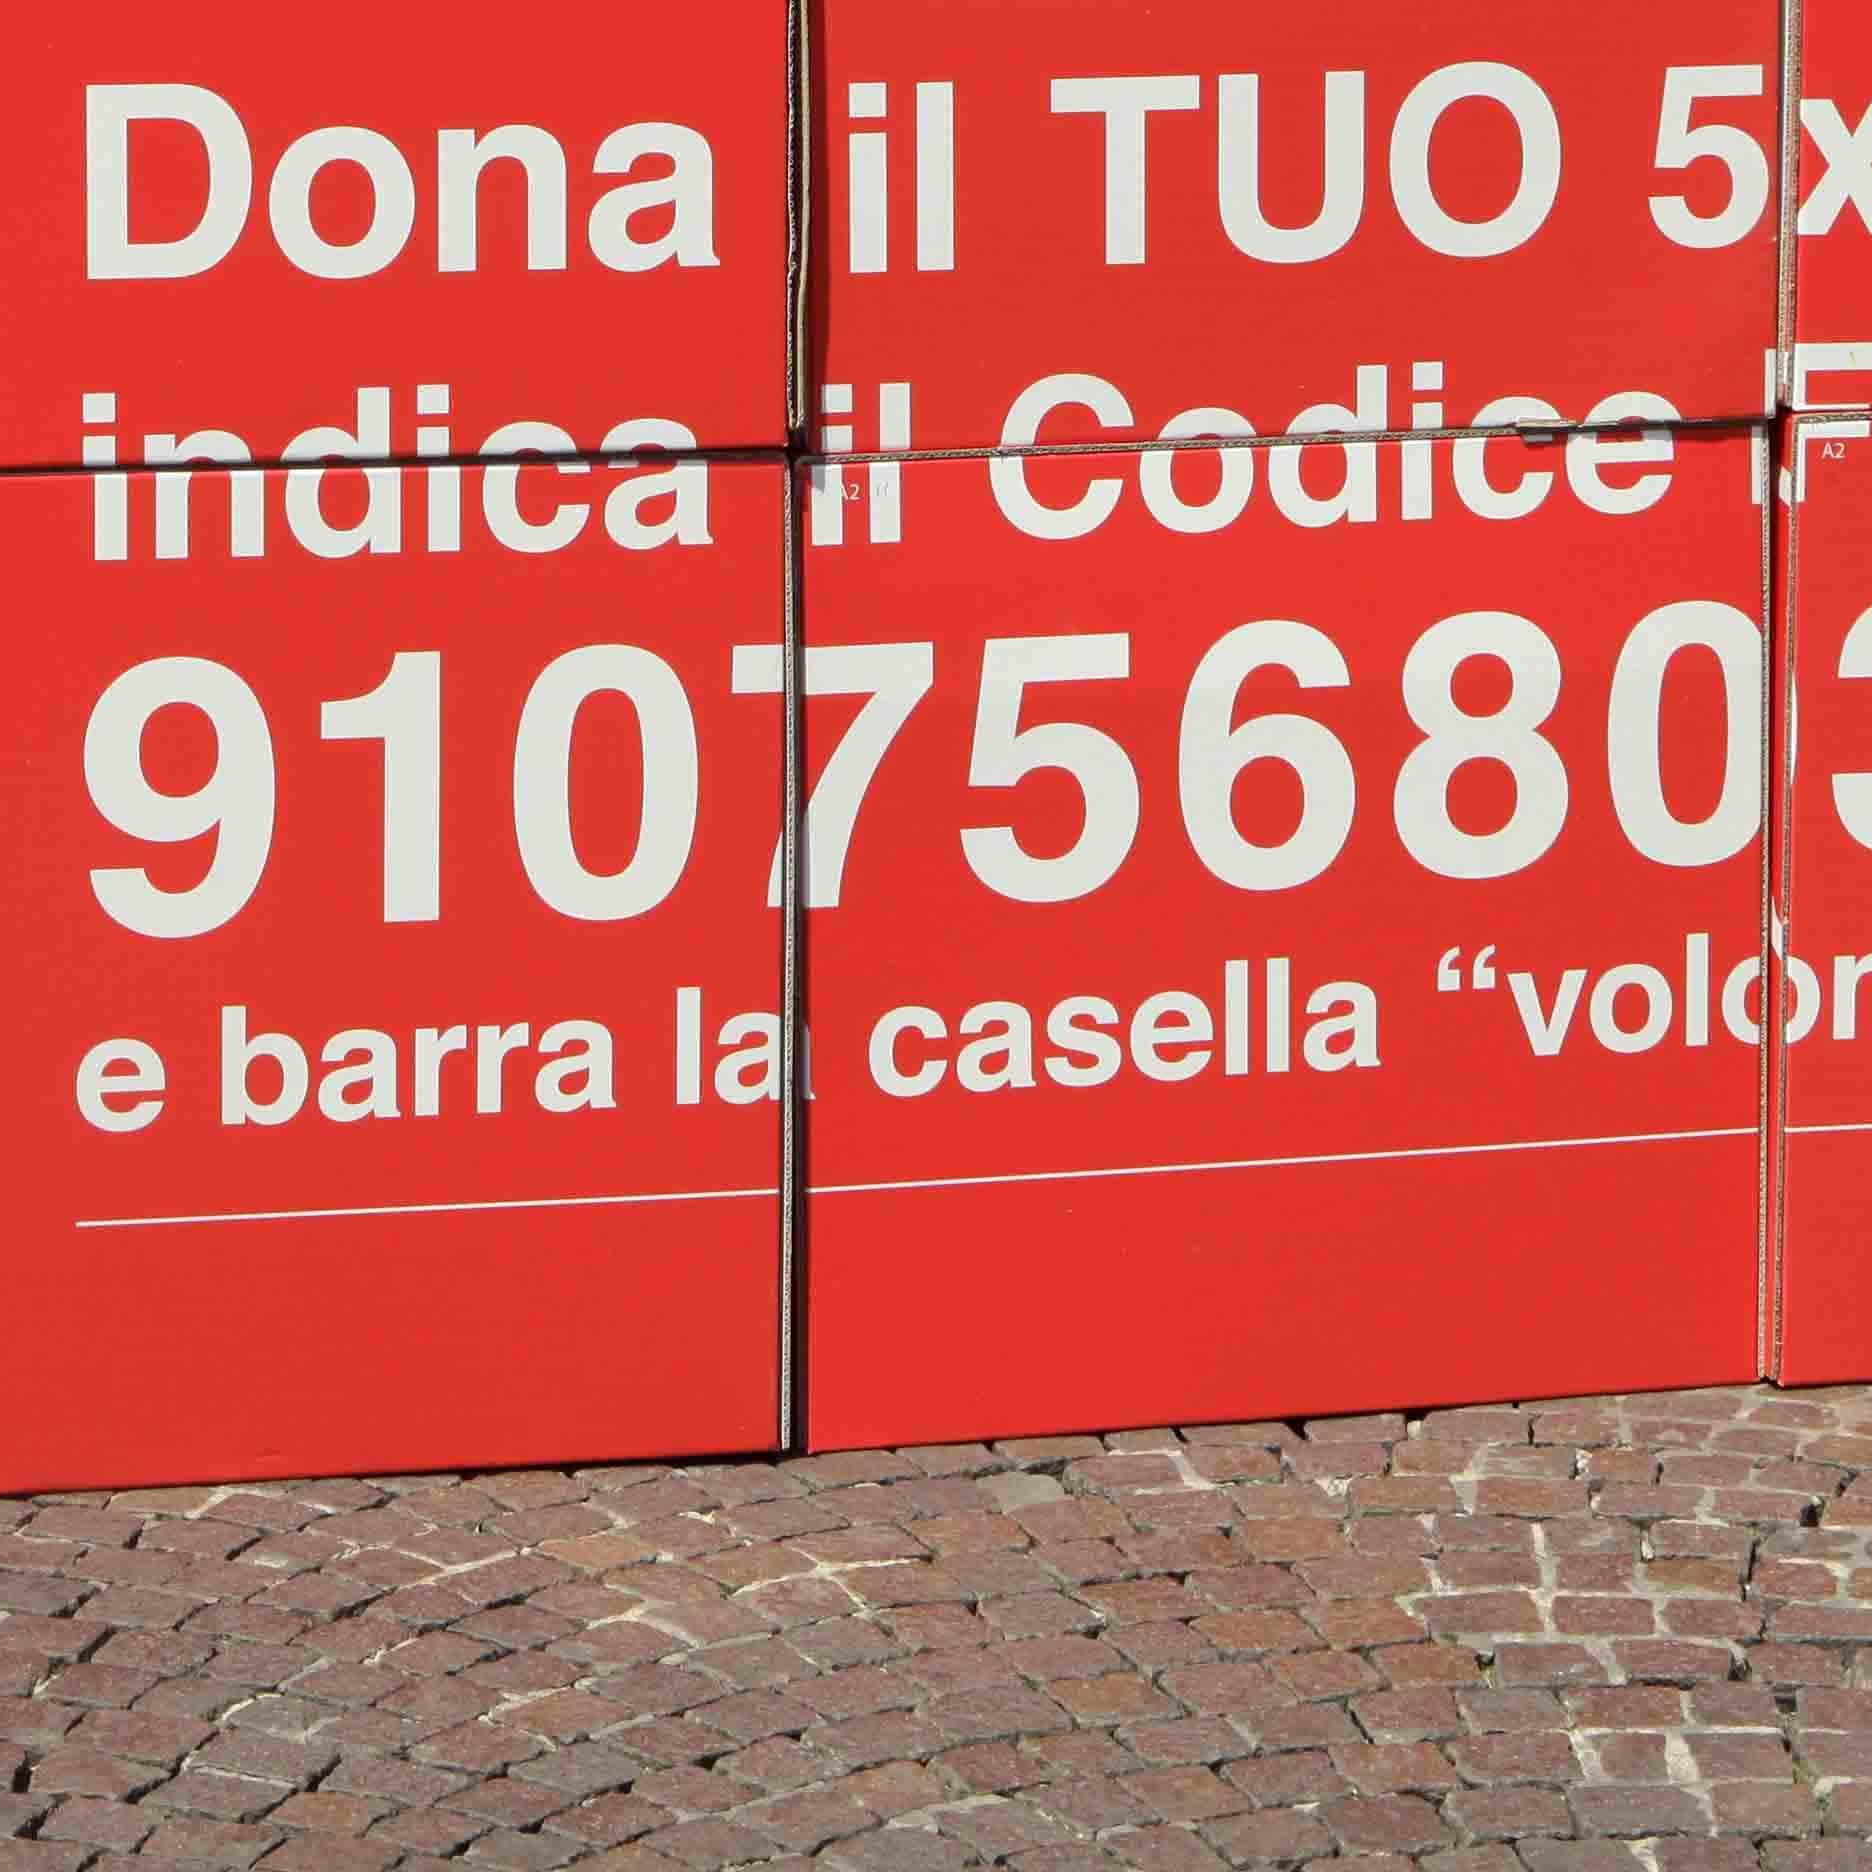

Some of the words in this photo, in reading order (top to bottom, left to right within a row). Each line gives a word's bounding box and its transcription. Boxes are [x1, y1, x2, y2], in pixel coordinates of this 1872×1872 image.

[85, 83, 722, 280] Dona
[847, 81, 956, 273] il
[1049, 61, 1562, 265] TUO
[81, 383, 714, 562] indica
[810, 382, 912, 547] il
[988, 361, 1682, 540] Codice
[1821, 442, 1846, 459] A2
[75, 1036, 167, 1133] e
[220, 1005, 618, 1126] barra
[674, 985, 816, 1106] la
[868, 957, 1382, 1098] casella
